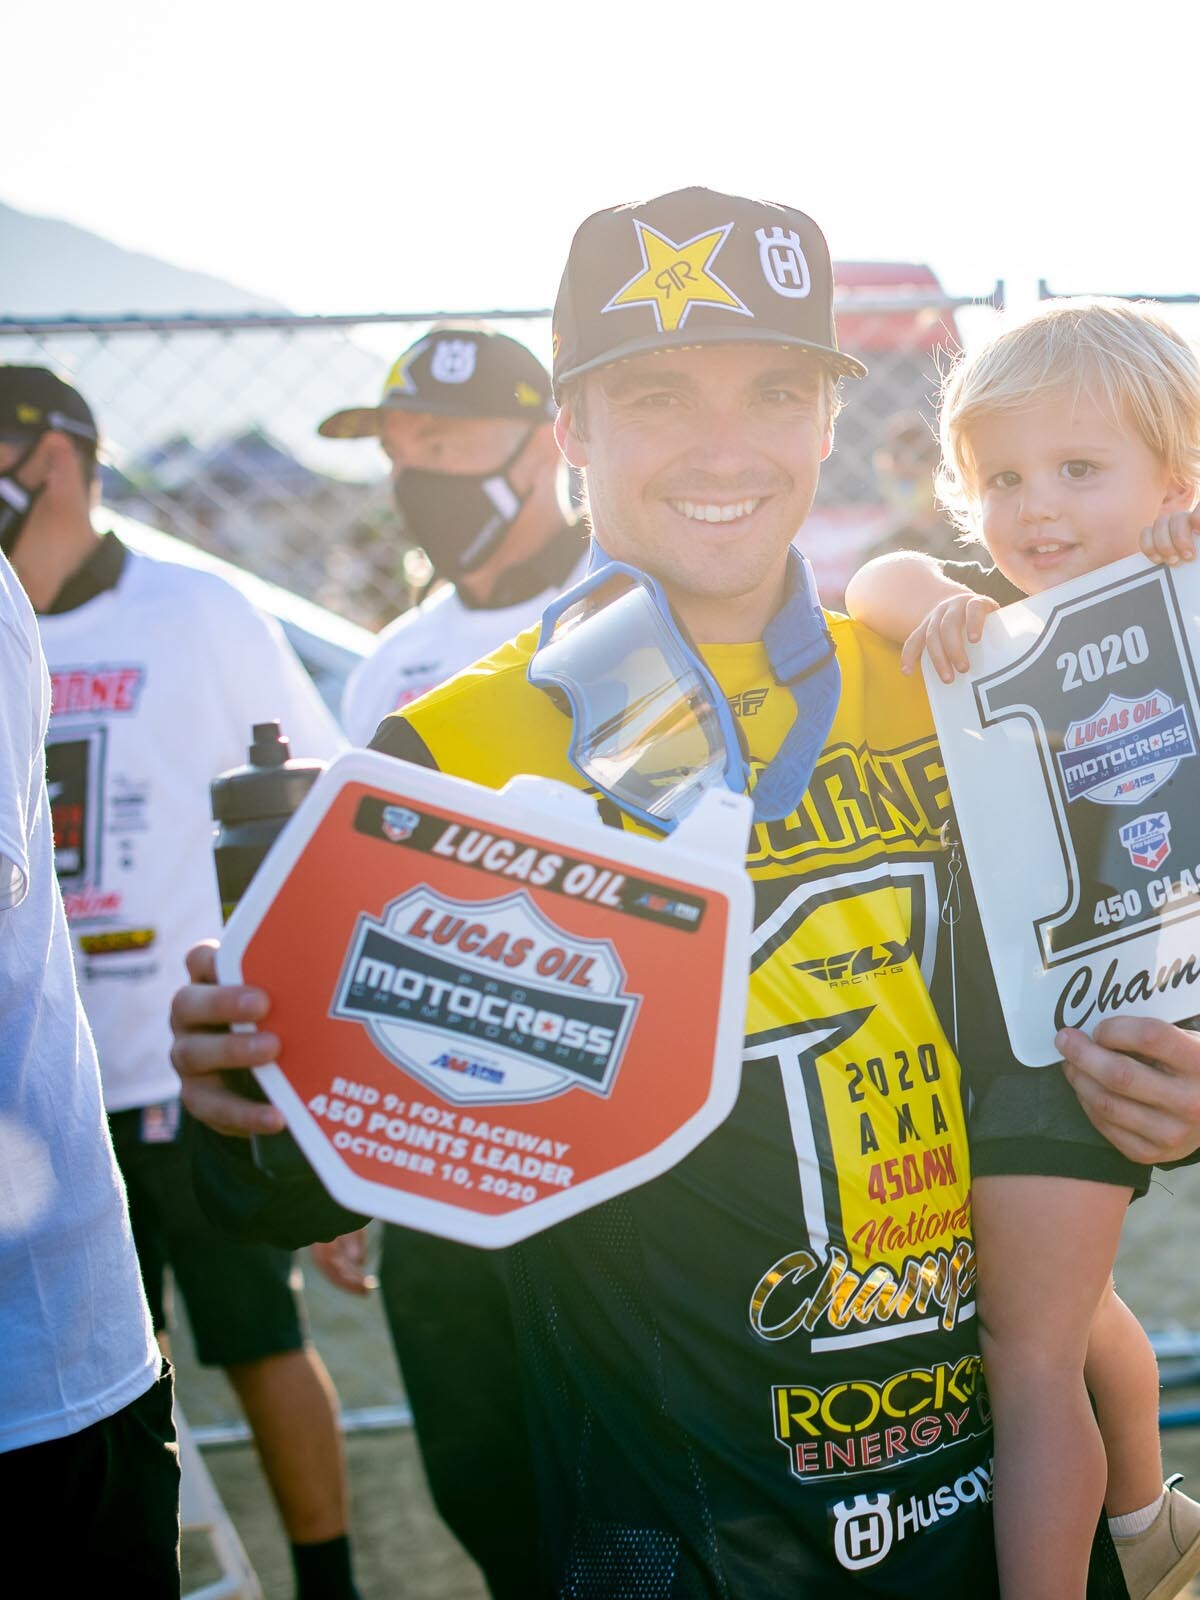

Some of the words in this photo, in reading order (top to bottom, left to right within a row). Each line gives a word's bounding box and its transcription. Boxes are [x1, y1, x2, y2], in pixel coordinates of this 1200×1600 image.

[1056, 625, 1150, 693] 2020
[1064, 724, 1188, 784] MOTOCROSS
[1074, 708, 1130, 747] LUCAS
[1133, 697, 1162, 724] OIL
[1068, 739, 1190, 791] CHAMPIONSHIP
[432, 824, 563, 886] LUCAS
[562, 864, 628, 907] OIL
[1093, 889, 1142, 927] 450
[408, 909, 535, 969] LUCAS
[535, 947, 597, 988] OIL
[791, 936, 914, 982] FLY
[829, 966, 904, 990] RACING
[355, 956, 616, 1056] MOTOCROSS
[458, 974, 527, 1003] PRO
[351, 981, 608, 1067] CHAMPIONSHIP
[845, 1043, 941, 1103] 2020
[308, 1094, 364, 1128] 450
[367, 1112, 468, 1161] POINTS
[471, 1143, 575, 1188] LEADER
[331, 1077, 380, 1106] RND
[383, 1093, 405, 1115] 9:
[408, 1102, 458, 1131] FOX
[458, 1116, 571, 1160] RACEWAY
[333, 1131, 437, 1176] OCTOBER
[440, 1164, 474, 1189] 10,
[478, 1174, 538, 1203] 2020
[867, 1143, 958, 1205] 450MX
[750, 1241, 977, 1341] Champ
[796, 1407, 970, 1473] ENERGY
